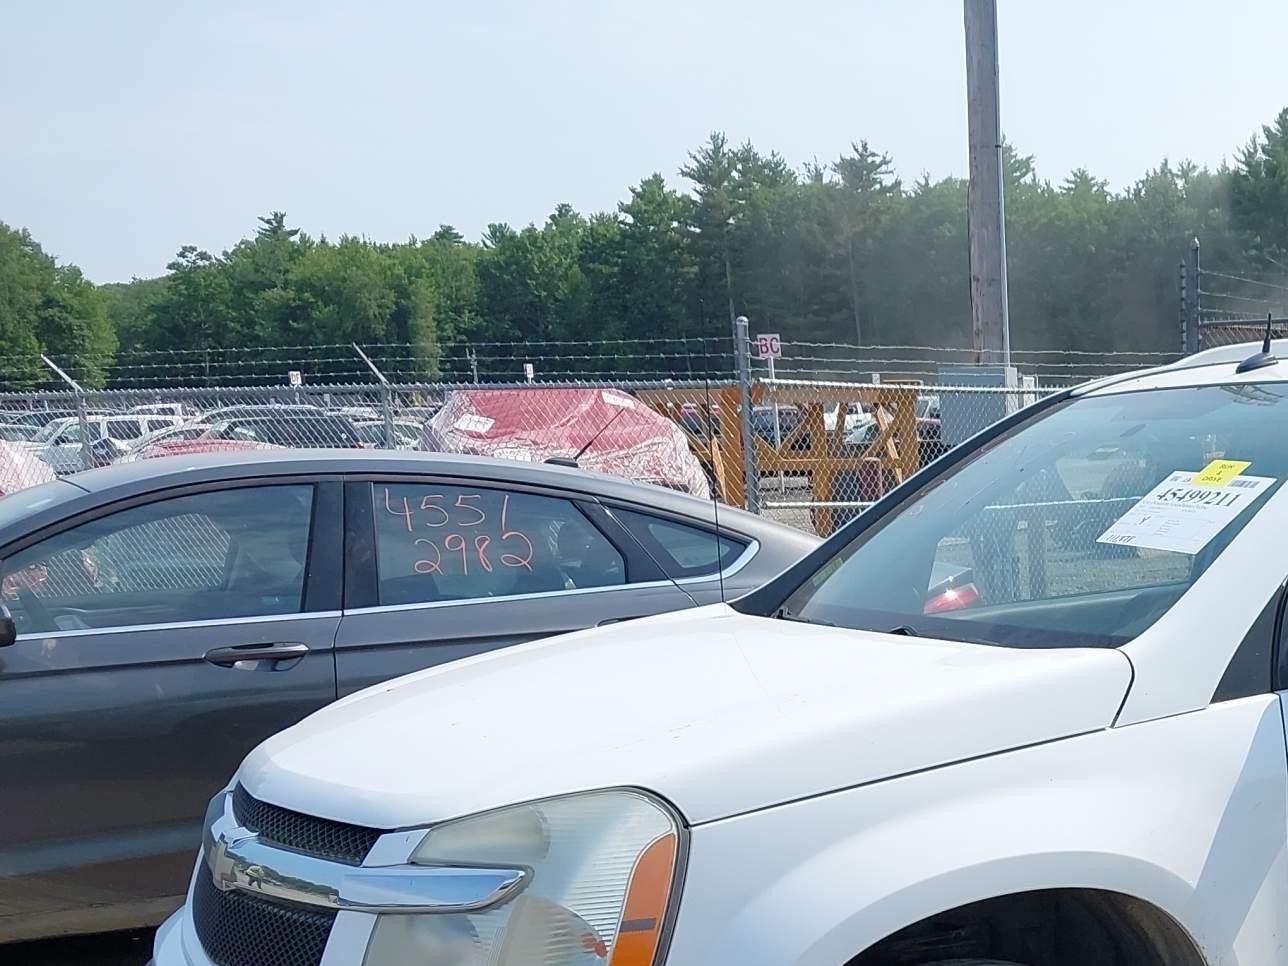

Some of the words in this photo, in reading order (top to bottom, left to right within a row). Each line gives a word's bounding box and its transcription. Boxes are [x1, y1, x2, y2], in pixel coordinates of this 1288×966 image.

[760, 338, 780, 354] BC
[385, 487, 509, 532] 4551
[1157, 488, 1240, 507] 45499211
[414, 531, 533, 576] 2982
